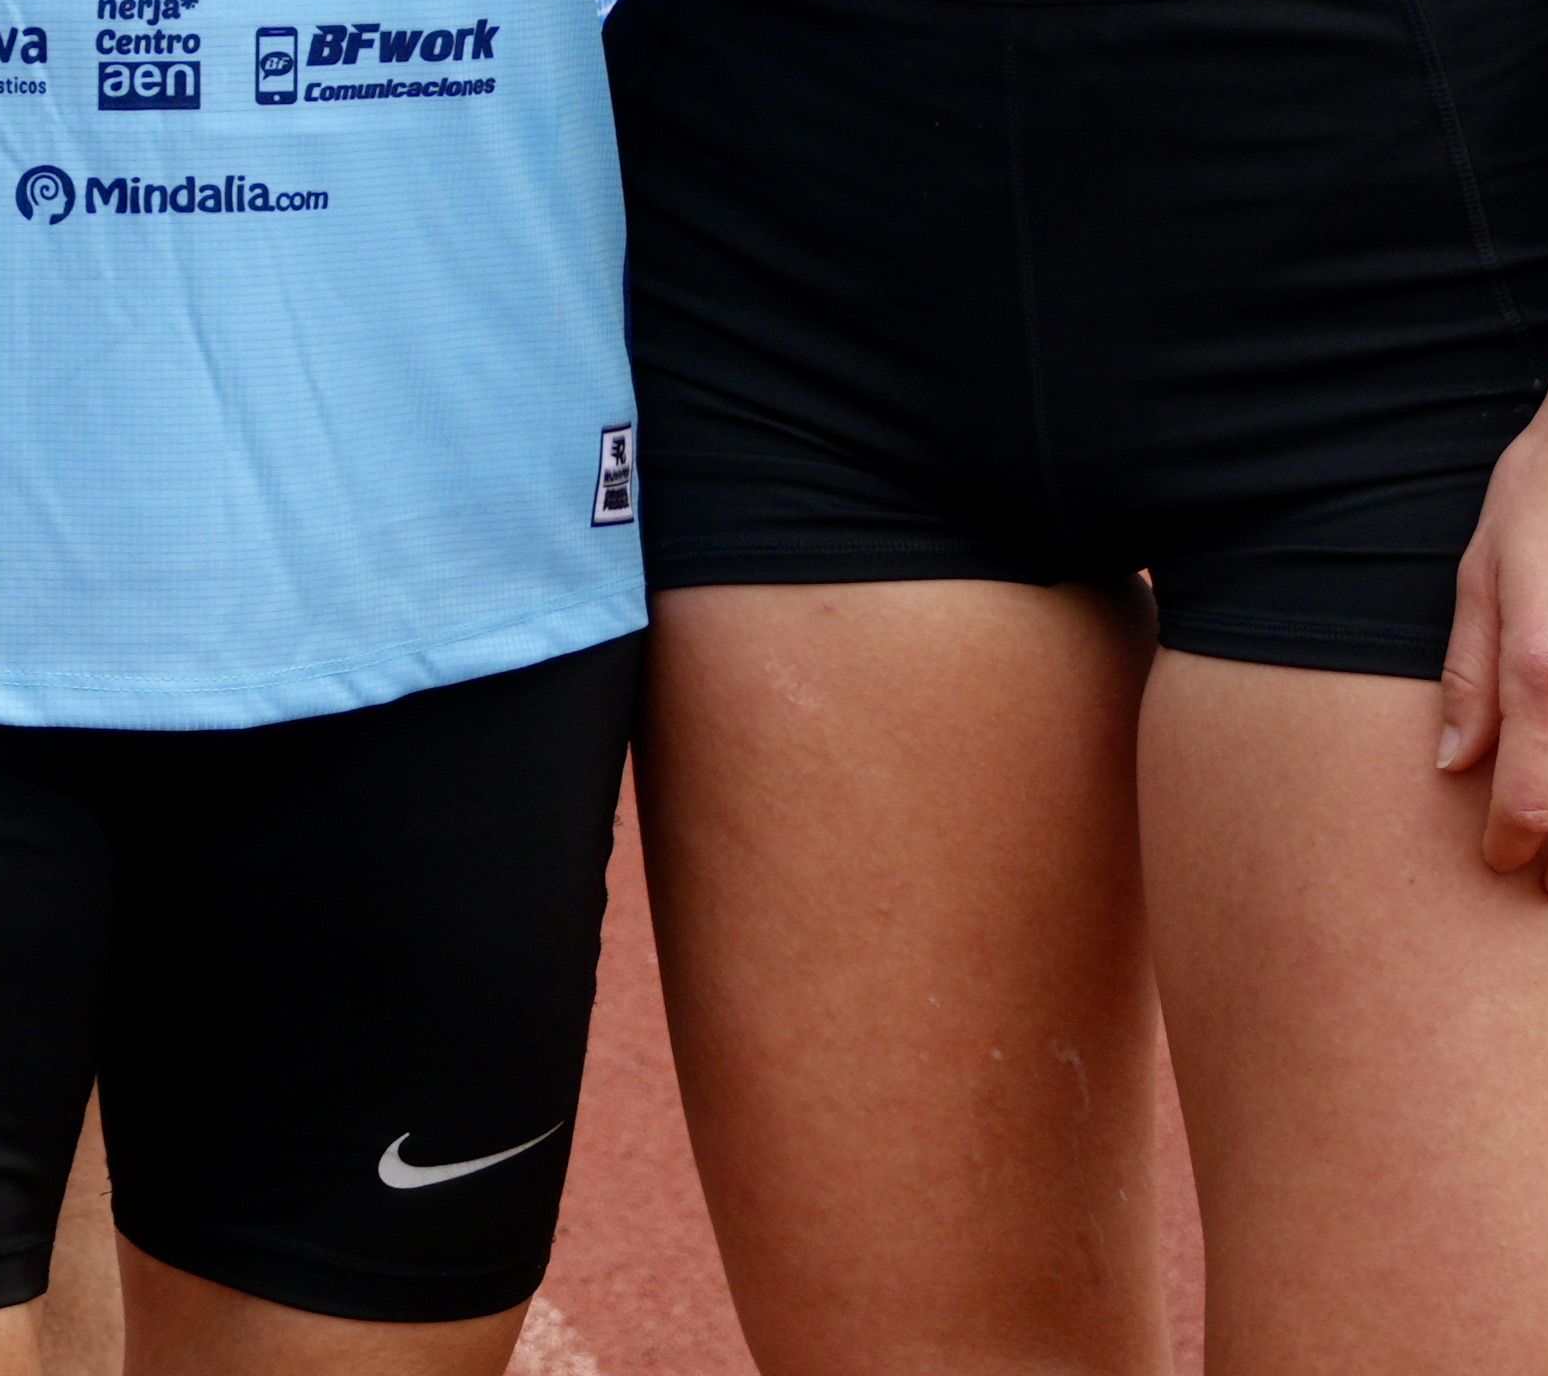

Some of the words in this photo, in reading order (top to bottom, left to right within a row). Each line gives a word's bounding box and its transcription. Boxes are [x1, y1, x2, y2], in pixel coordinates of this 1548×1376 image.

[94, 27, 201, 56] Centro
[306, 18, 501, 68] BFwork
[102, 62, 197, 100] aen
[303, 75, 497, 105] Comunicaciones
[85, 173, 329, 217] Mindalia.com
